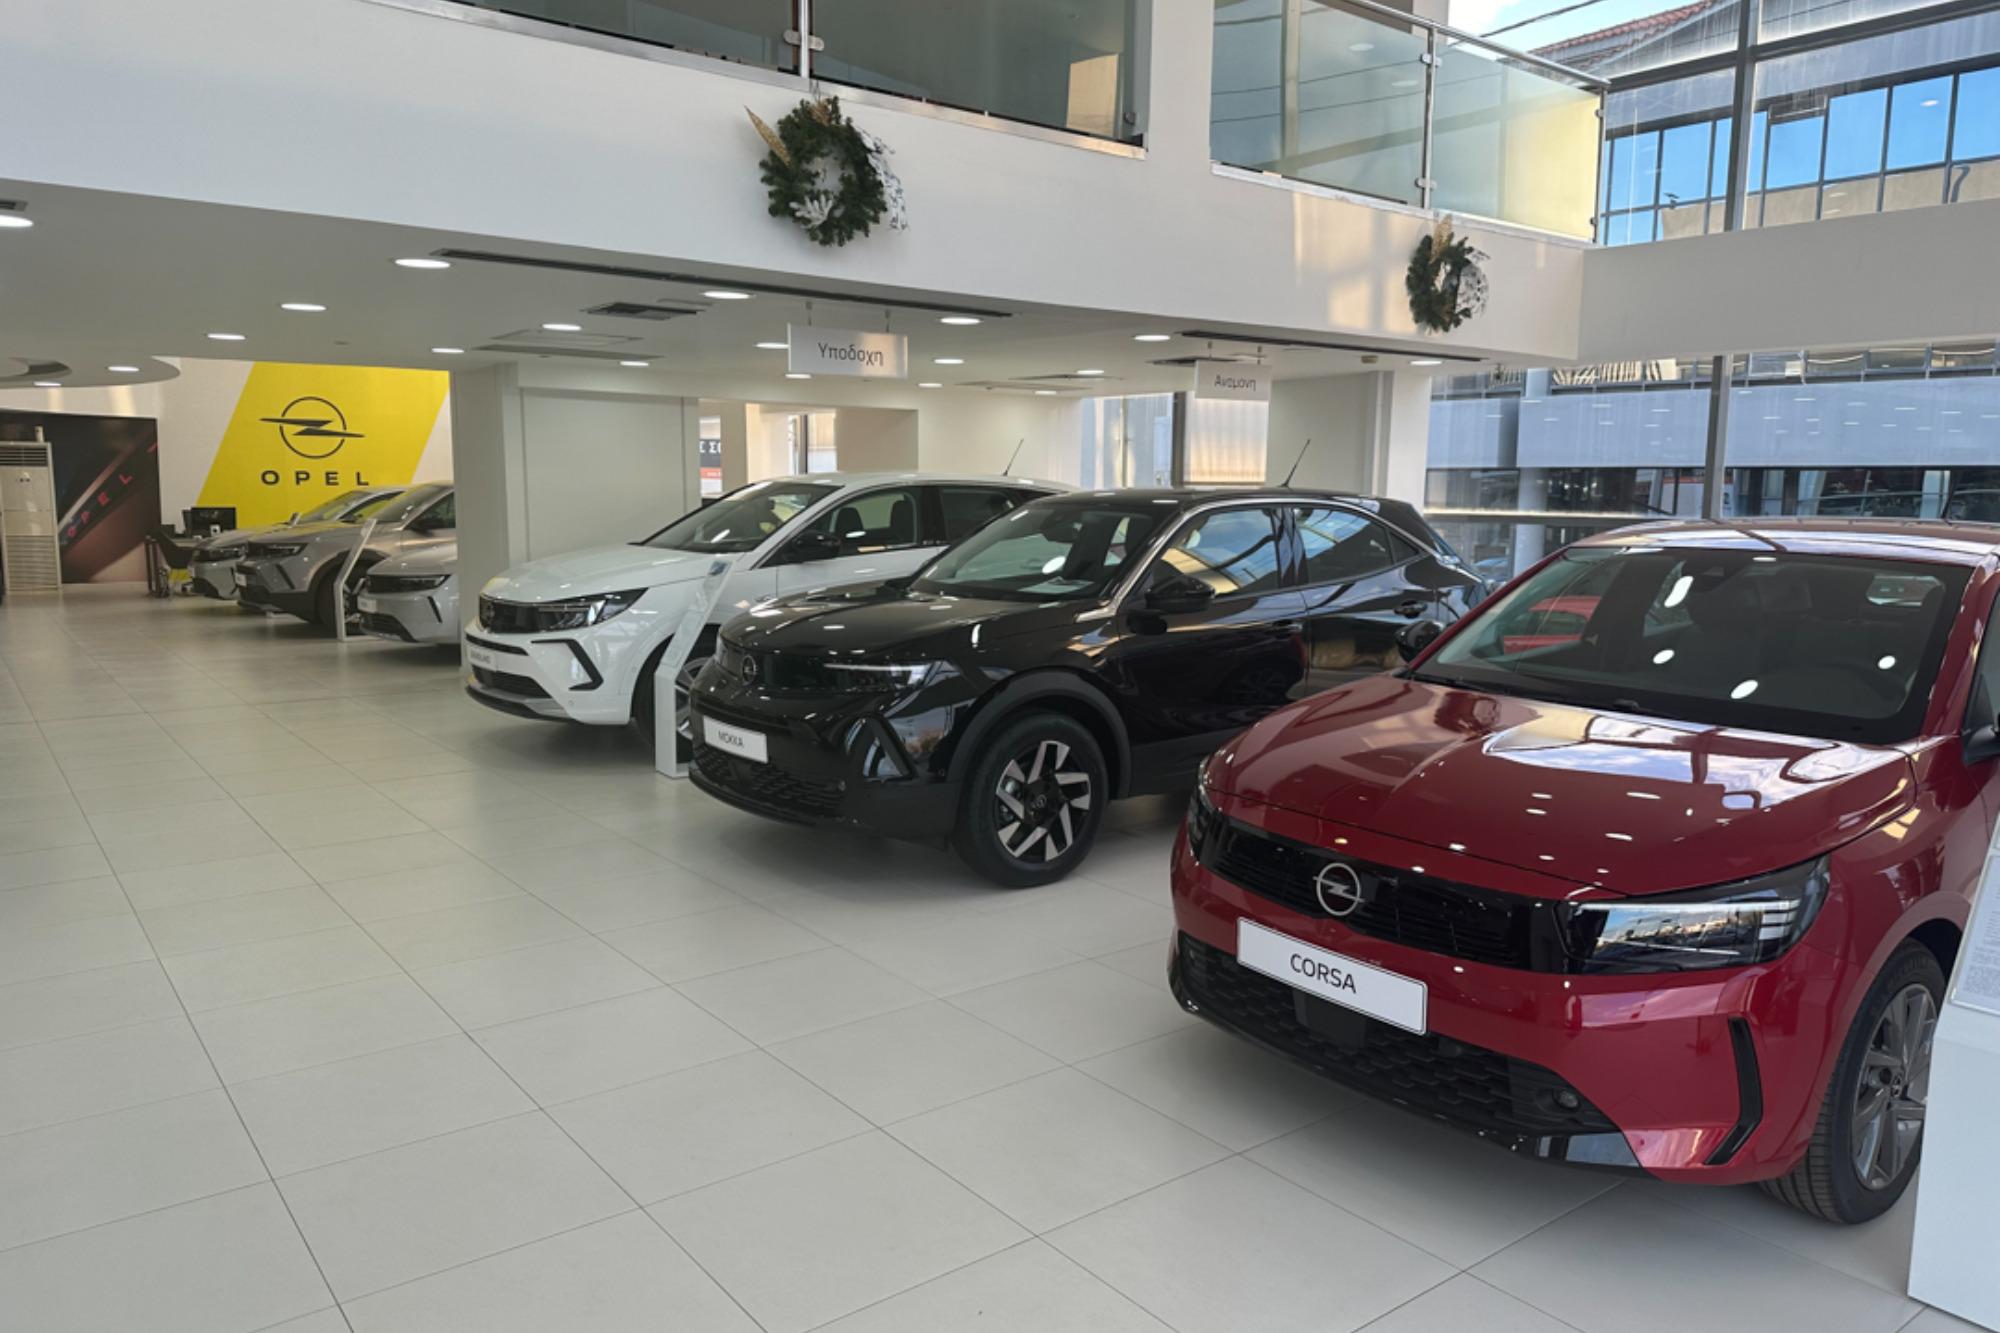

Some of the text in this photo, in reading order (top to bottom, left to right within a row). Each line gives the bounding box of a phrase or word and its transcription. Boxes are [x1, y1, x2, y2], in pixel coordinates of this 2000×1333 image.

[817, 342, 884, 366] Υποδοχη
[261, 470, 369, 486] OPEL
[66, 474, 134, 538] OPEL
[718, 730, 745, 748] MOKKA
[1290, 953, 1357, 994] CORSA
